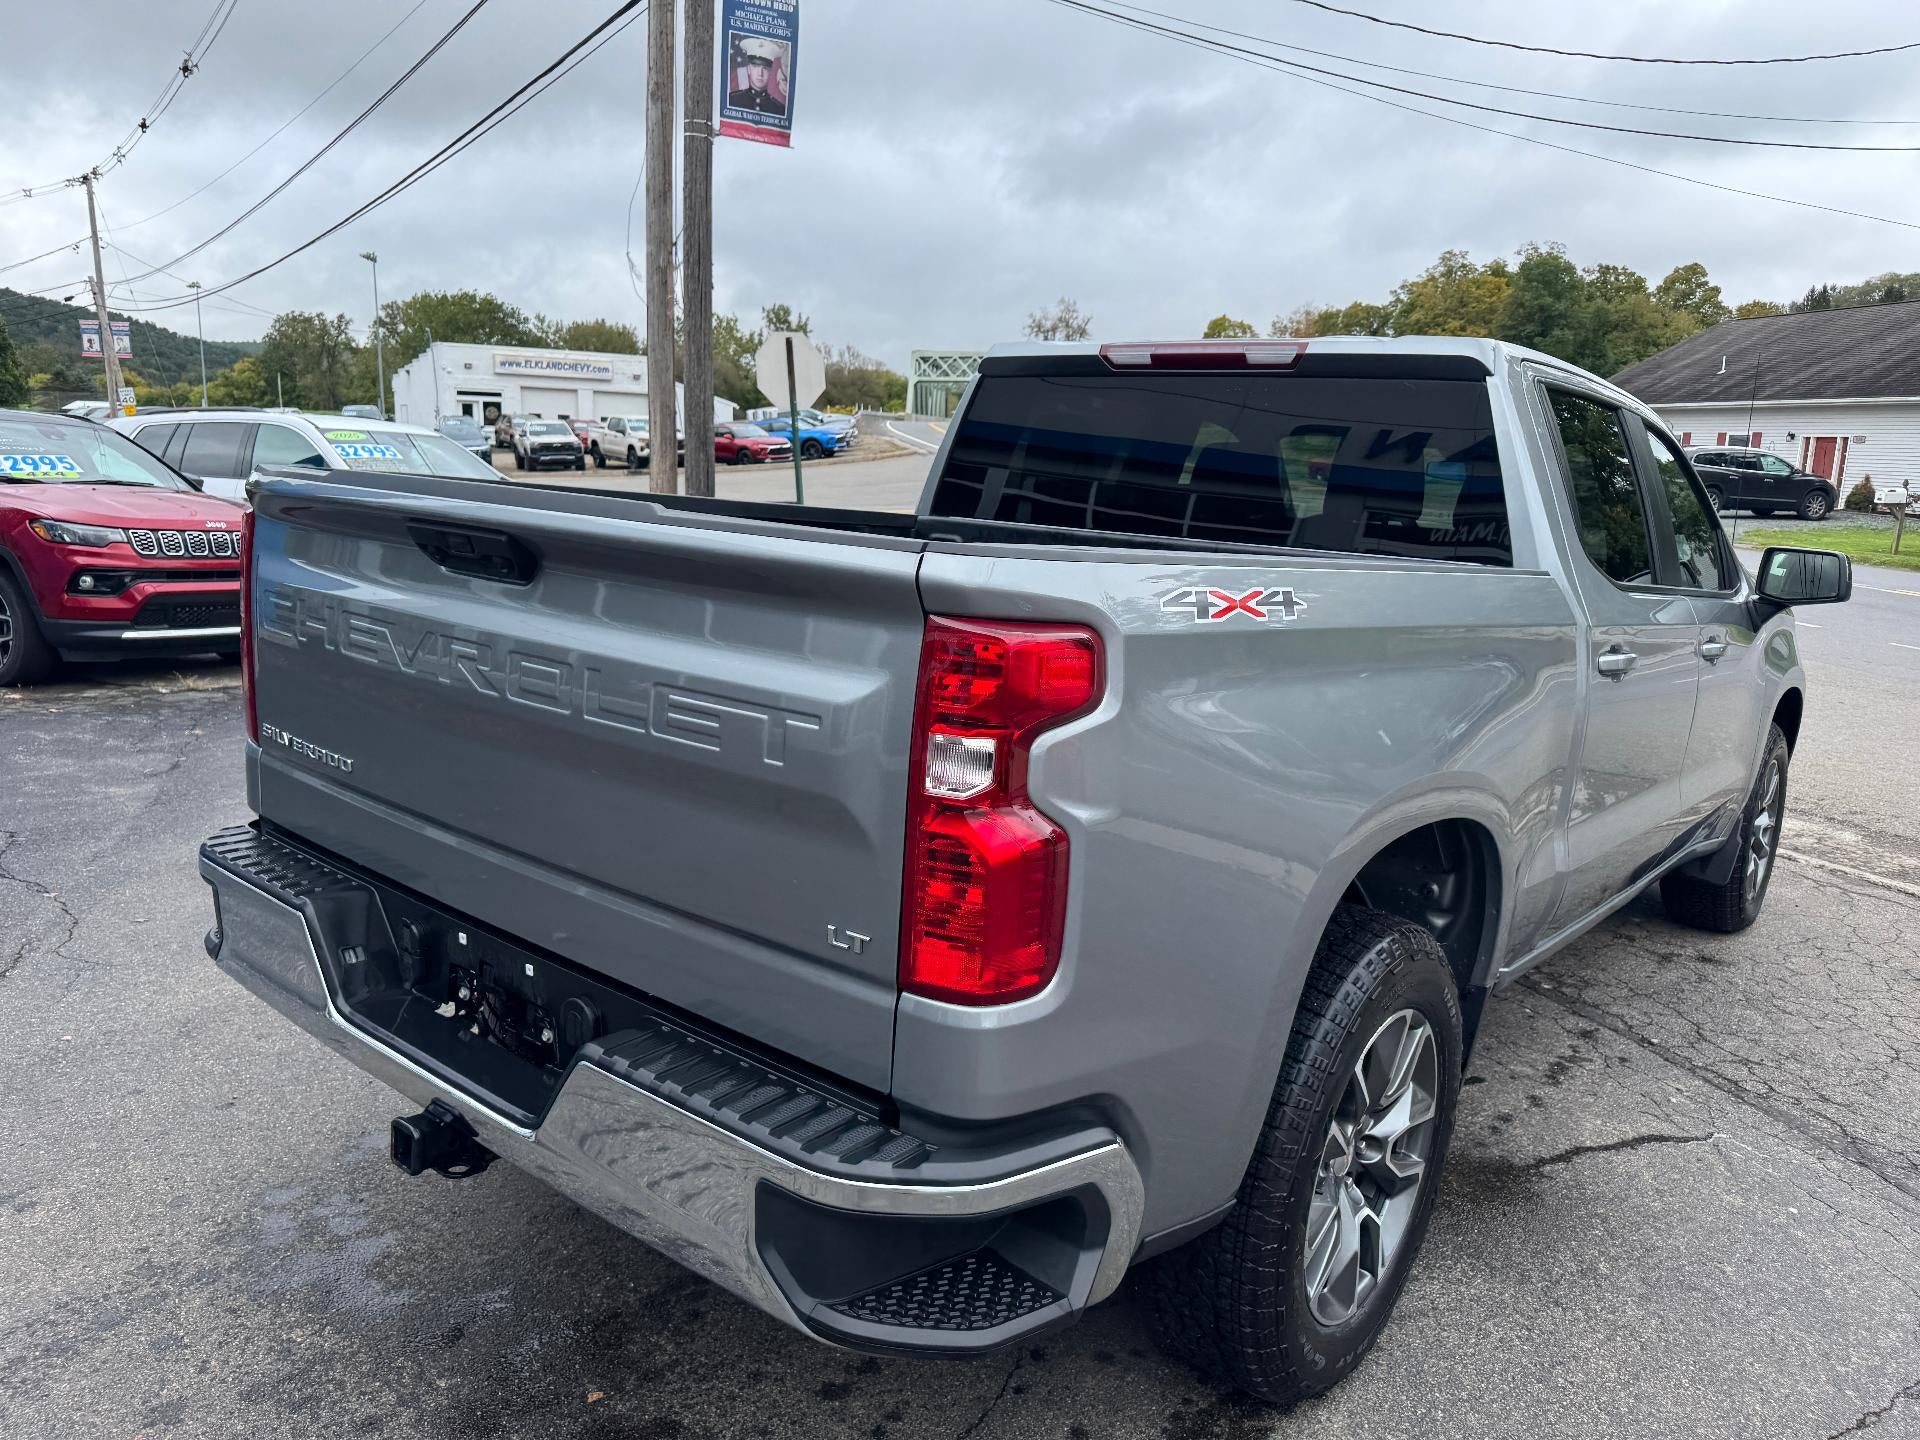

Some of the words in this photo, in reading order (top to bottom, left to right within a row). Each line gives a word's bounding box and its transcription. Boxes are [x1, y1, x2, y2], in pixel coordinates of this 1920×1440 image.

[773, 1, 794, 13] HERO
[735, 10, 765, 22] MICHAEL
[730, 18, 743, 28] U.S.
[743, 21, 769, 33] MARINE
[769, 26, 791, 37] CORPS
[499, 359, 610, 374] www.ELKLANDCHEVY.com
[122, 396, 135, 404] 40
[334, 444, 398, 458] 32995
[205, 520, 227, 530] Jeep
[263, 588, 822, 766] CHEVROLET
[261, 721, 355, 774] SILVERADO
[826, 924, 872, 954] LT
